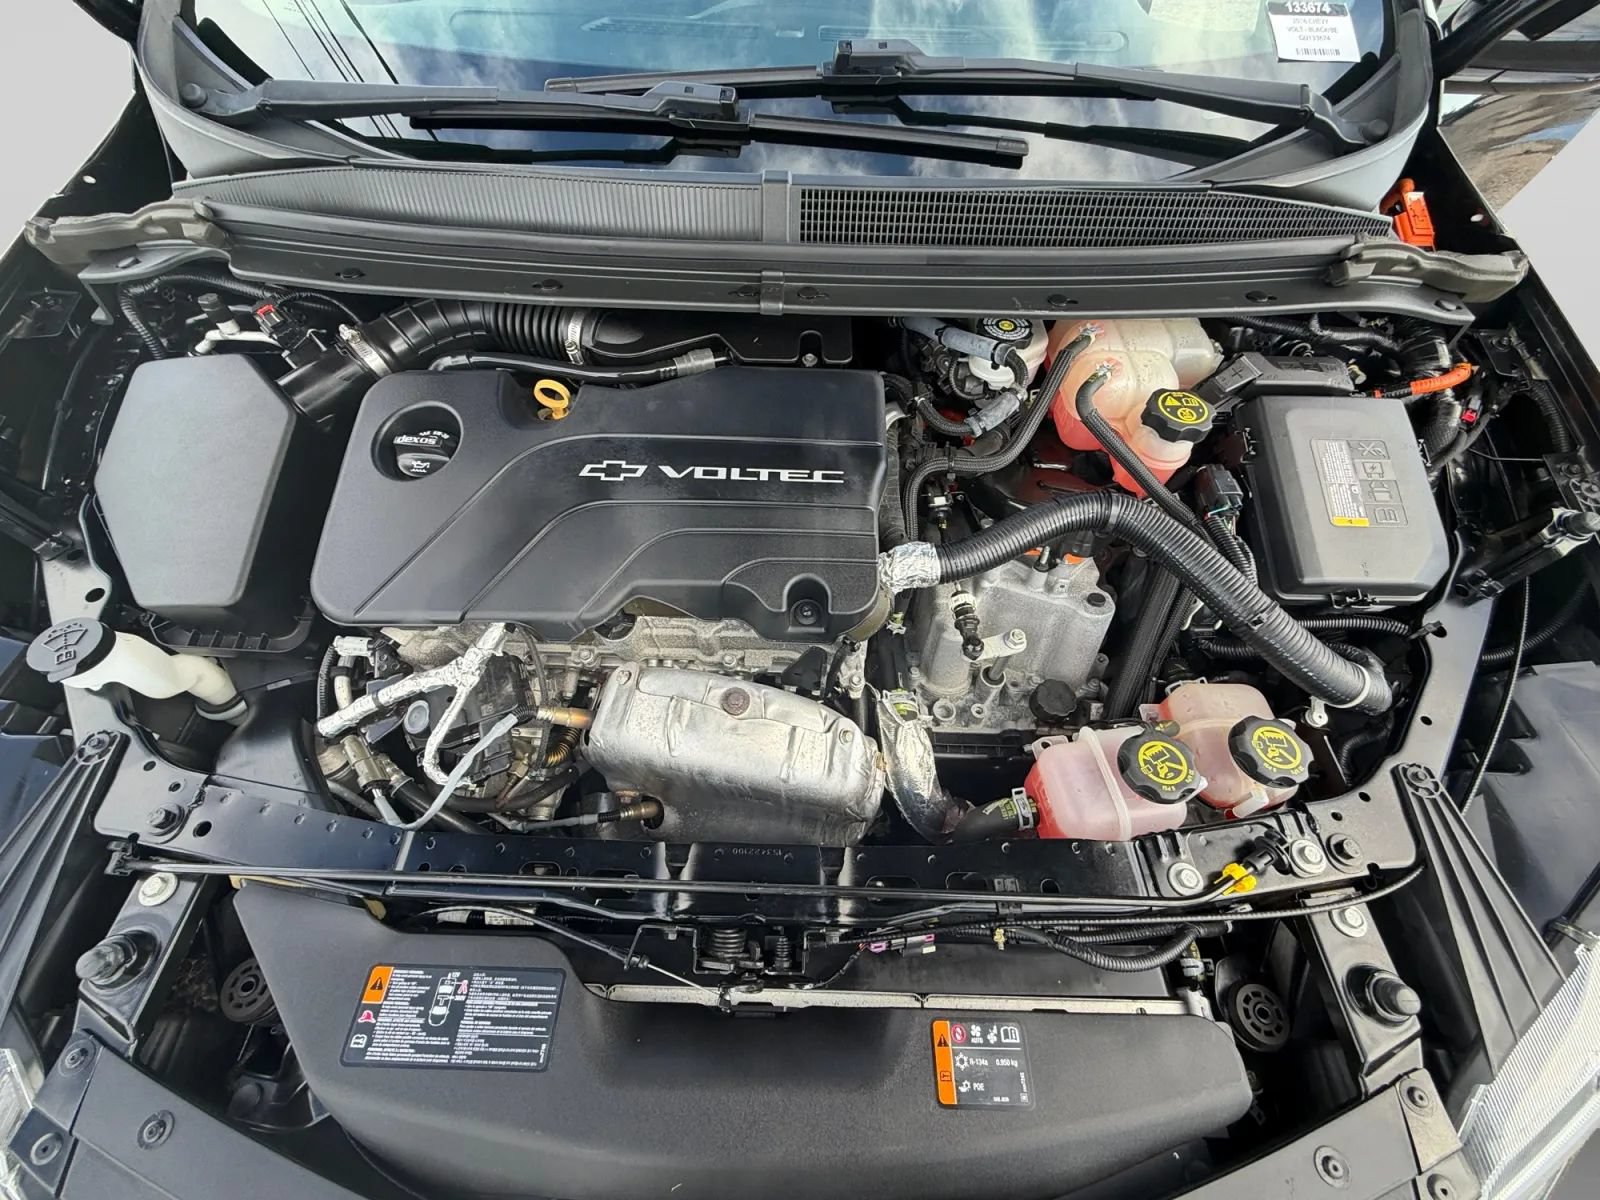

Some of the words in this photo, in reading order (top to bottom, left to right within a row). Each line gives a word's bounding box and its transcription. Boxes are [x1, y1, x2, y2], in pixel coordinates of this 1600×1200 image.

[1285, 1, 1331, 13] 133674
[396, 435, 437, 445] dexos
[658, 466, 845, 483] VOLTEC
[973, 1083, 985, 1091] POE
